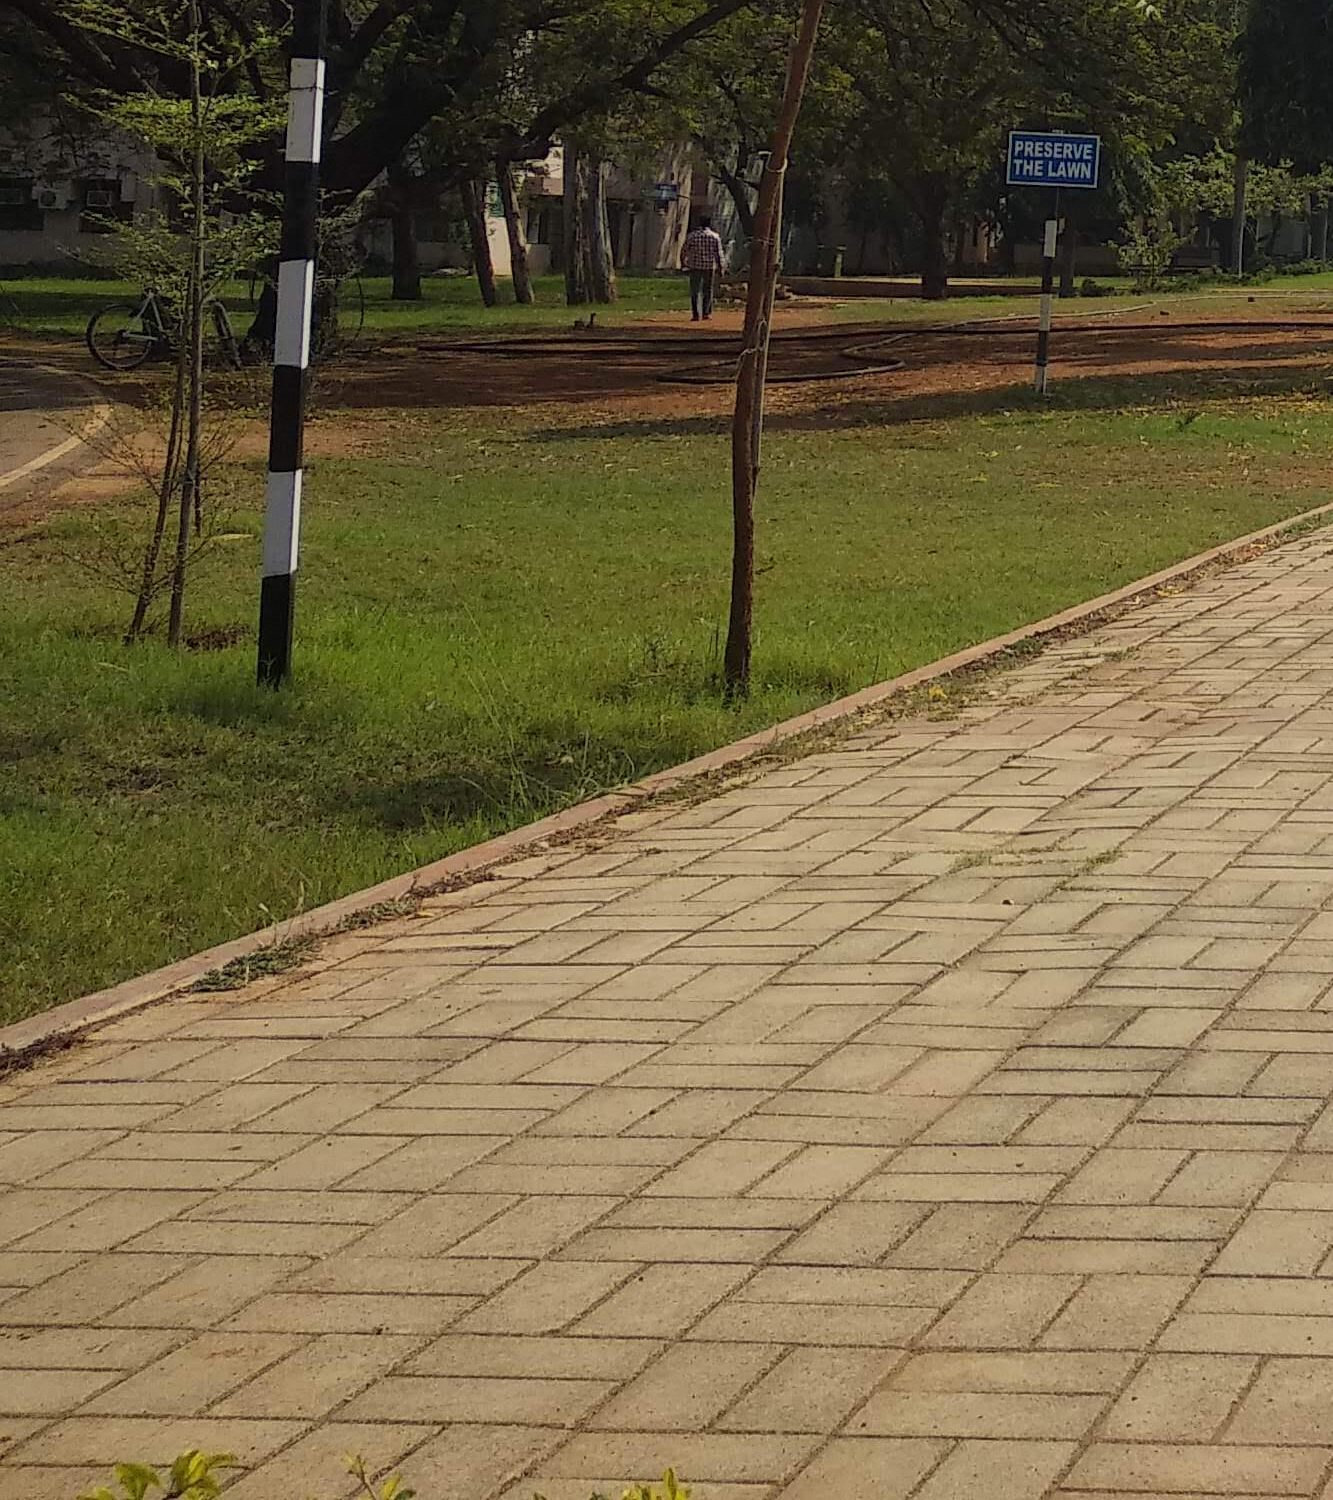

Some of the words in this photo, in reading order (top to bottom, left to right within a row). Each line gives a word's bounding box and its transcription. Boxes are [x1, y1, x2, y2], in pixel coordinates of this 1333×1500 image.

[1014, 140, 1093, 160] PRESERVE
[1012, 160, 1044, 177] THE
[1047, 161, 1092, 179] LAWN
